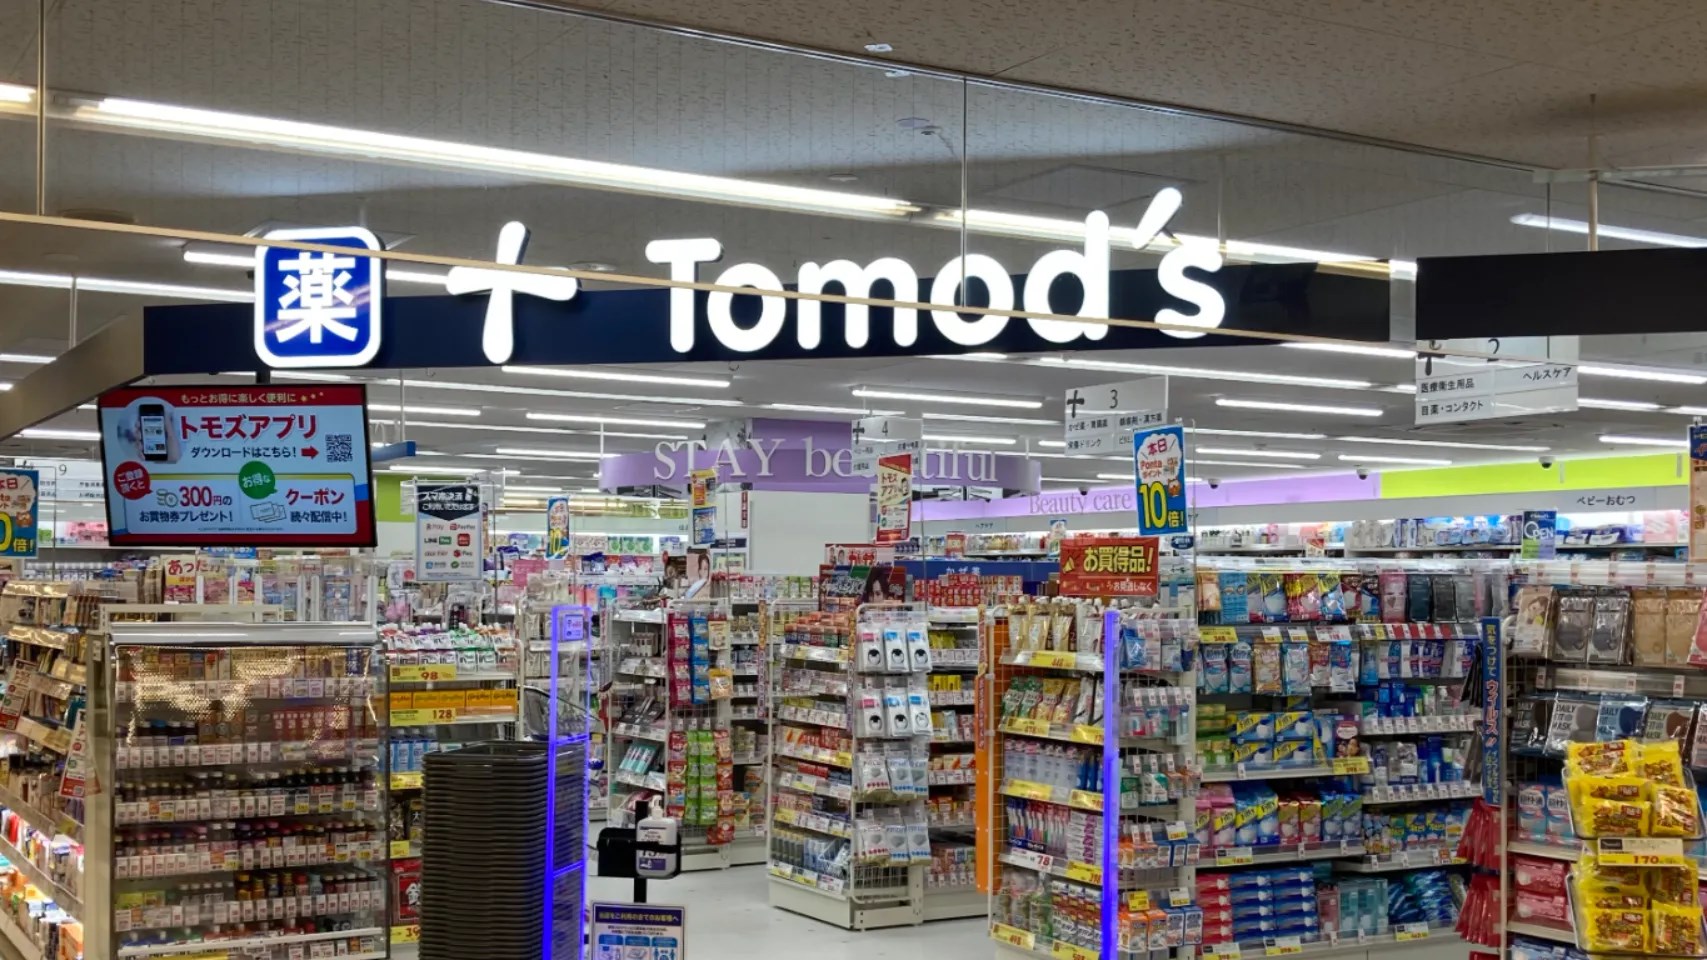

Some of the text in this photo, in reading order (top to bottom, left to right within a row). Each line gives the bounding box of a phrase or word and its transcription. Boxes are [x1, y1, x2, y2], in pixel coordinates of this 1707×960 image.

[645, 187, 1226, 353] Tomod's
[275, 251, 359, 344] 薬
[1523, 367, 1571, 381] ヘルスケア
[1421, 378, 1475, 393] 医療衛生用品
[181, 393, 296, 405] もっとお得に楽しく便利に
[1109, 389, 1118, 409] 3
[1421, 401, 1484, 416] 目薬・コンタクト
[180, 414, 317, 440] トモズアプリ
[882, 421, 889, 434] 4
[190, 446, 296, 458] ダウンロードはこちら！
[1147, 439, 1167, 455] 本日
[653, 436, 998, 482] STAY betiful
[59, 464, 67, 475] 9
[242, 473, 271, 488] お得な
[285, 488, 345, 506] クーポン
[1029, 490, 1132, 514] Beauty care
[139, 511, 234, 522] お買物券プレゼント！
[290, 511, 347, 522] 続々配信中！
[1524, 521, 1554, 540] OPEN
[1083, 546, 1155, 573] お買得品！
[421, 671, 439, 680] 98
[432, 709, 453, 719] 128
[1556, 702, 1576, 713] DAILY
[1649, 711, 1667, 721] DAILY
[1038, 855, 1051, 866] 78
[1633, 856, 1659, 864] 170
